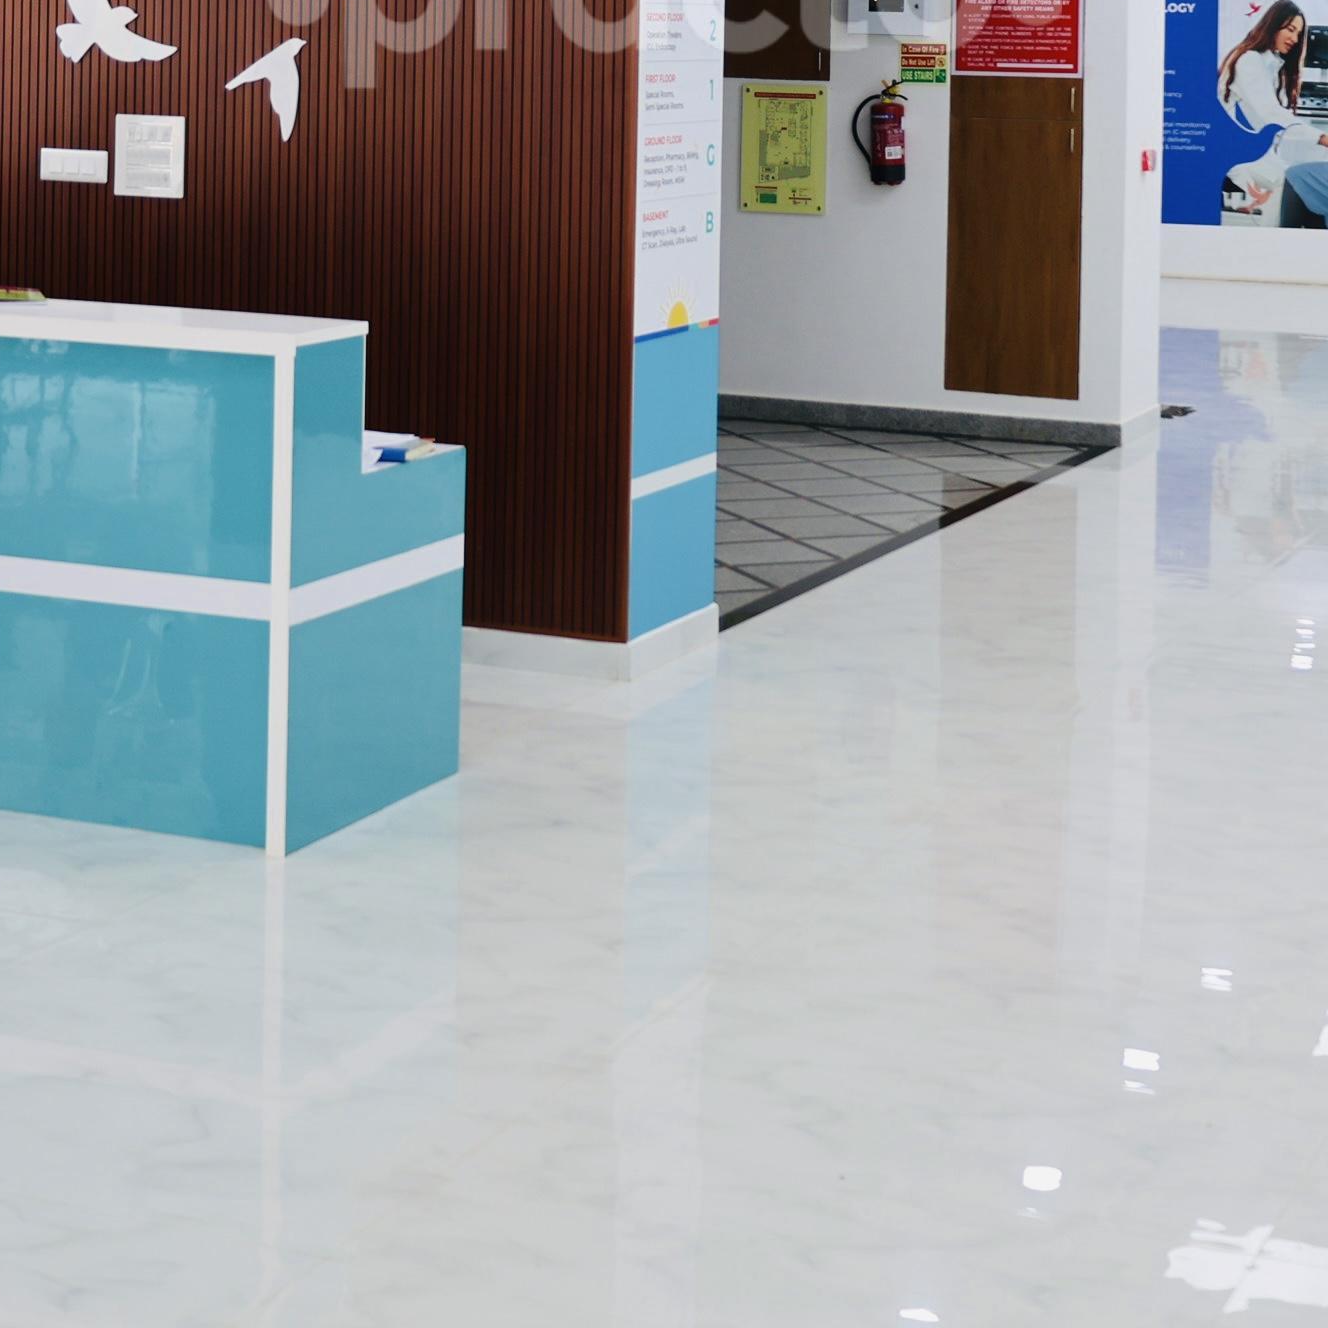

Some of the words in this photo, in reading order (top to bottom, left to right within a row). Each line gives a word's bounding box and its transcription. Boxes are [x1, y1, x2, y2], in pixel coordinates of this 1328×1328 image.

[667, 13, 684, 22] FLOOR
[710, 19, 717, 41] 2
[901, 45, 908, 54] In
[908, 45, 922, 54] Case
[921, 45, 929, 54] Of
[929, 45, 939, 54] Fire
[901, 58, 908, 67] Do
[908, 58, 917, 67] Not
[917, 58, 927, 67] Use
[926, 58, 935, 67] Lift
[902, 71, 913, 80] USE
[914, 71, 934, 80] STAIRS
[645, 73, 658, 83] FIRST
[659, 73, 676, 83] FLOOR
[709, 79, 714, 101] 1
[644, 136, 665, 146] GROUND
[666, 135, 683, 144] FLOOR
[706, 143, 715, 166] G
[642, 209, 669, 223] BASEMENT
[706, 211, 714, 233] B
